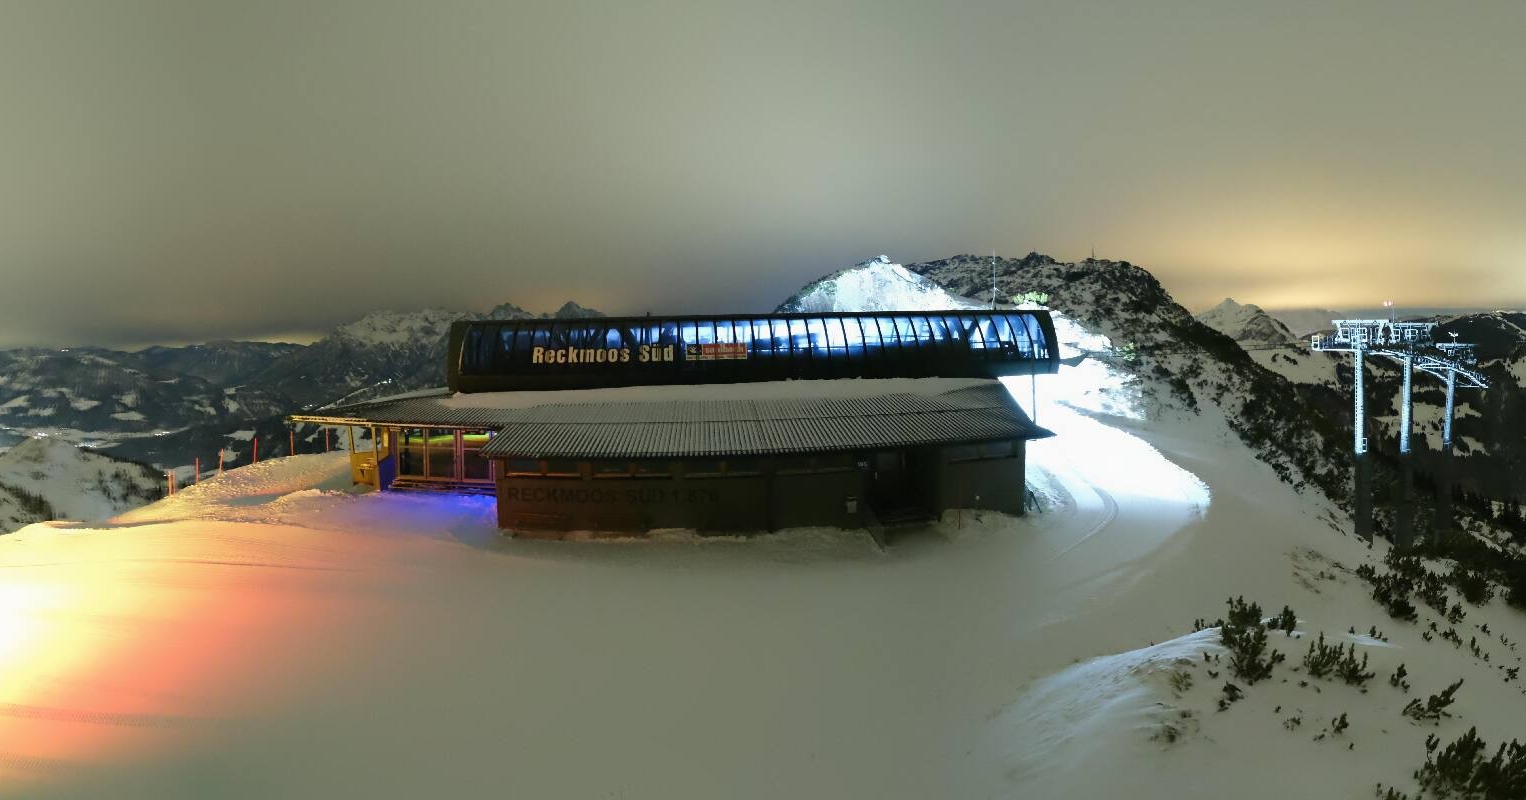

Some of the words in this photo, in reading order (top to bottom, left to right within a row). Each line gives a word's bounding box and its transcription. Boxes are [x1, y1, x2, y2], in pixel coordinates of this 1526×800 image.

[532, 346, 630, 364] Reckmoos
[639, 344, 674, 361] Süd
[507, 487, 618, 504] RECKMOOS
